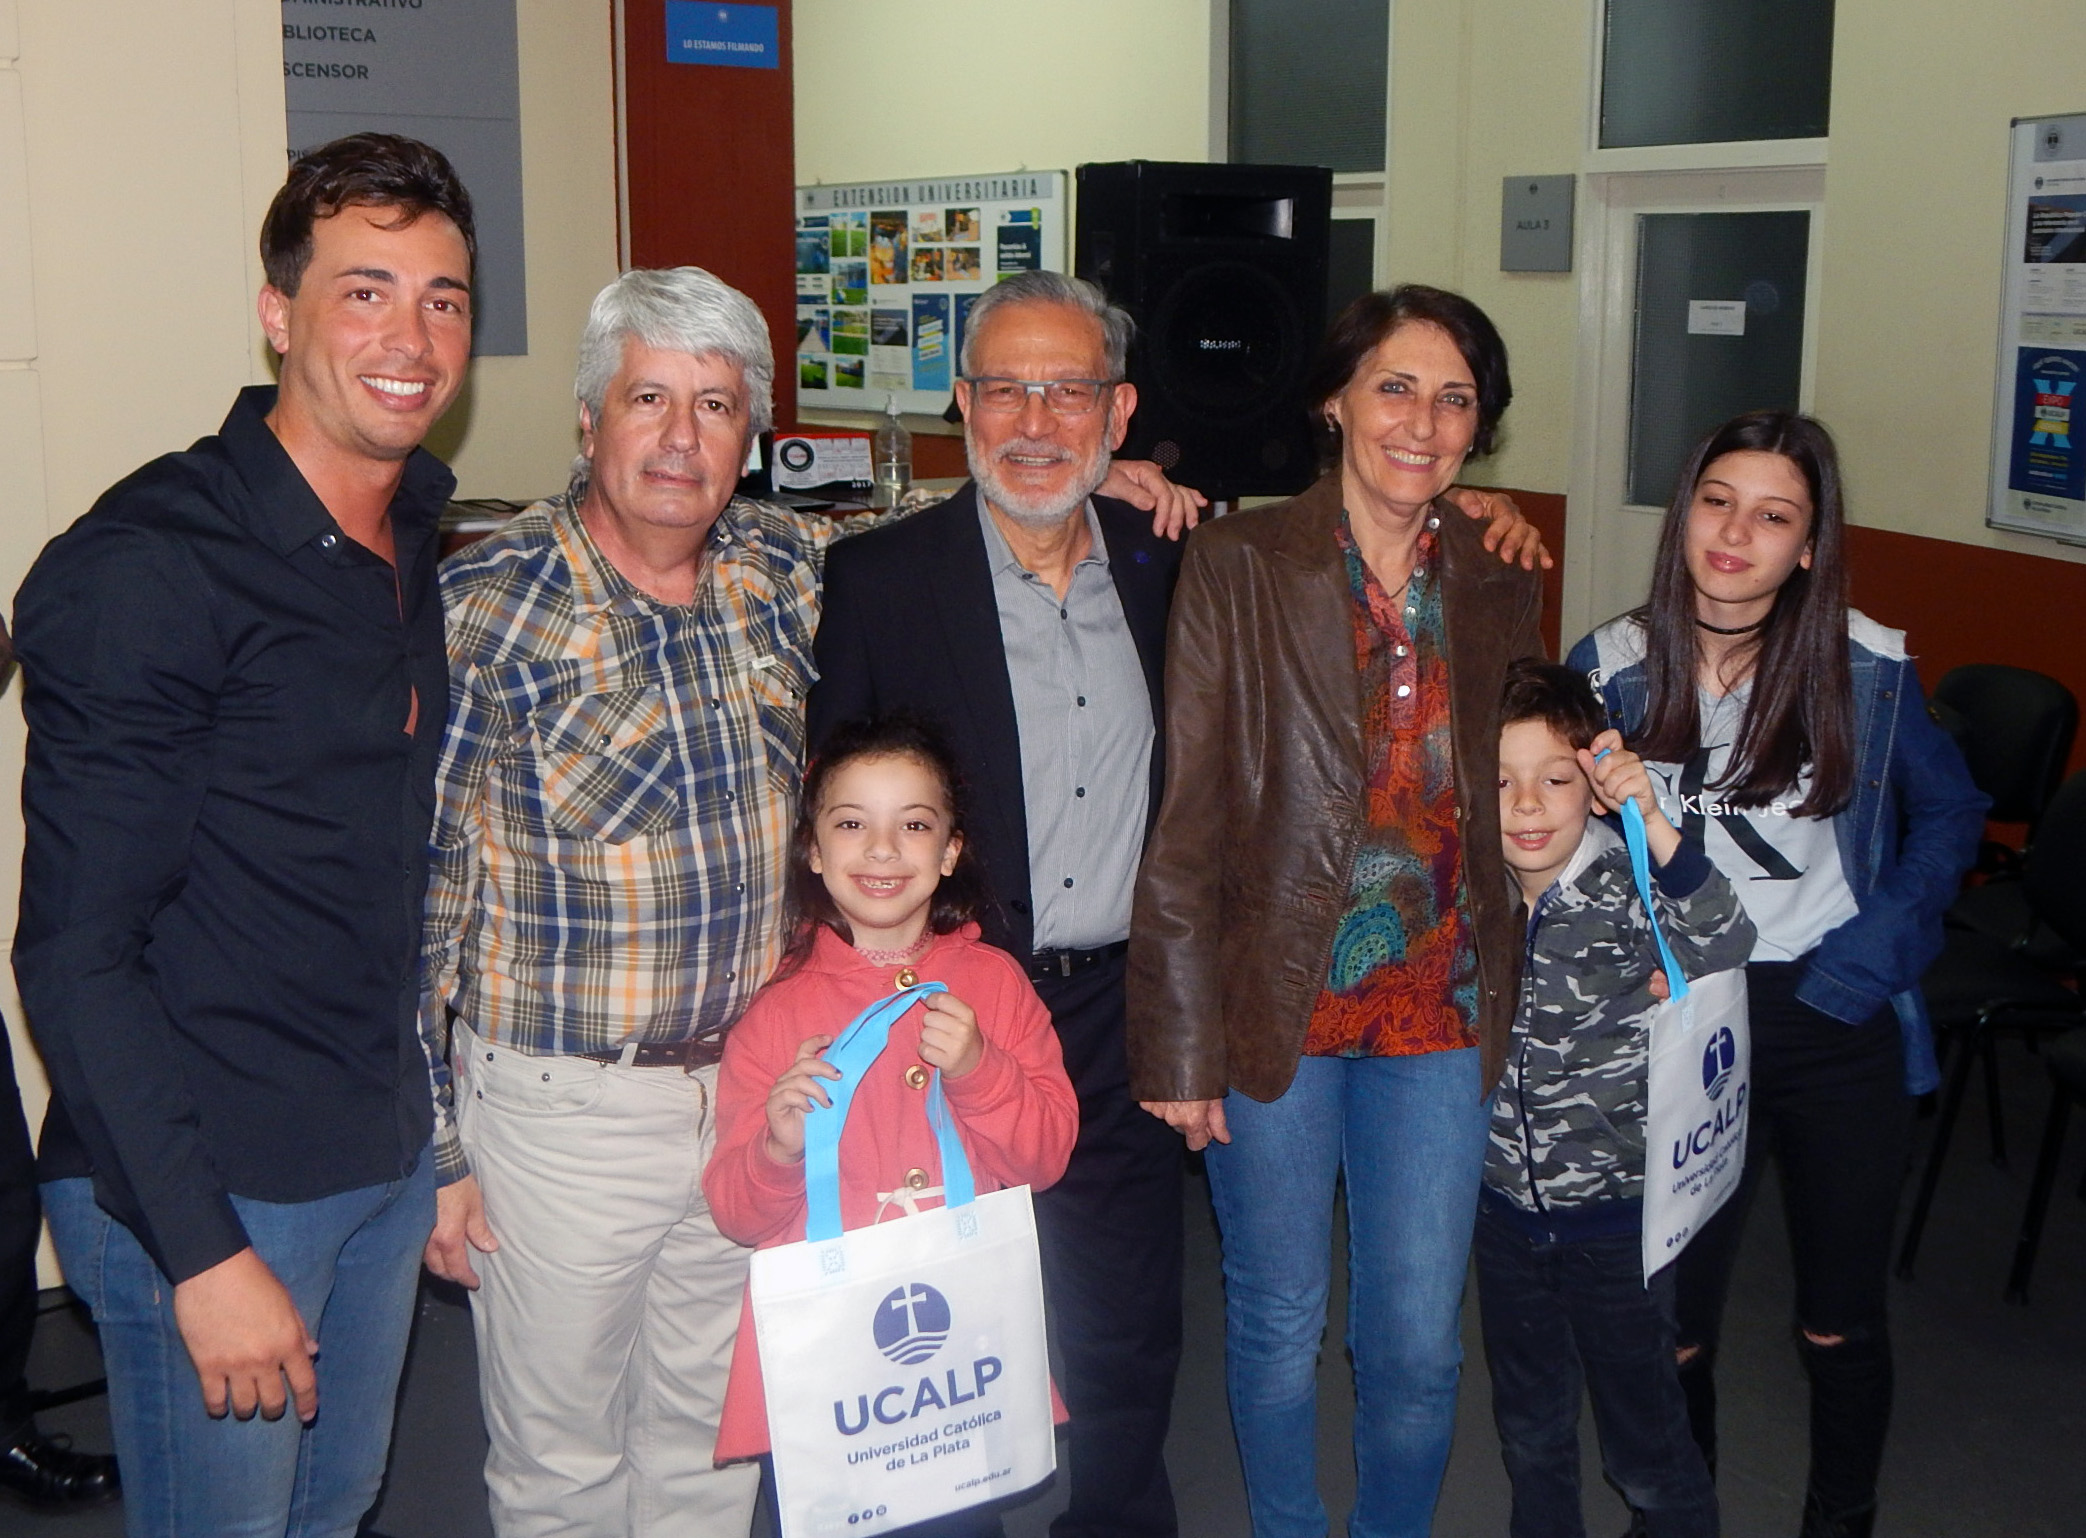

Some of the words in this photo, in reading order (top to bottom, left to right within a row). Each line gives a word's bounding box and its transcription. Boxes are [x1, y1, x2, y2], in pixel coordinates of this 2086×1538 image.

[683, 39, 692, 49] LO
[694, 40, 726, 51] ESTAMOS
[727, 42, 765, 53] FILMANDO
[918, 178, 1038, 202] UNIVERSITARIA
[1516, 220, 1541, 231] AULA
[851, 481, 872, 489] 2017
[1672, 1082, 1747, 1170] UCALP
[833, 1356, 1003, 1436] UCALP
[847, 1428, 939, 1465] Universidad
[943, 1409, 1002, 1437] Católica
[886, 1458, 906, 1472] de
[910, 1452, 929, 1465] La
[933, 1438, 971, 1458] Plata
[955, 1467, 1012, 1492] ucalp.edu.ar
